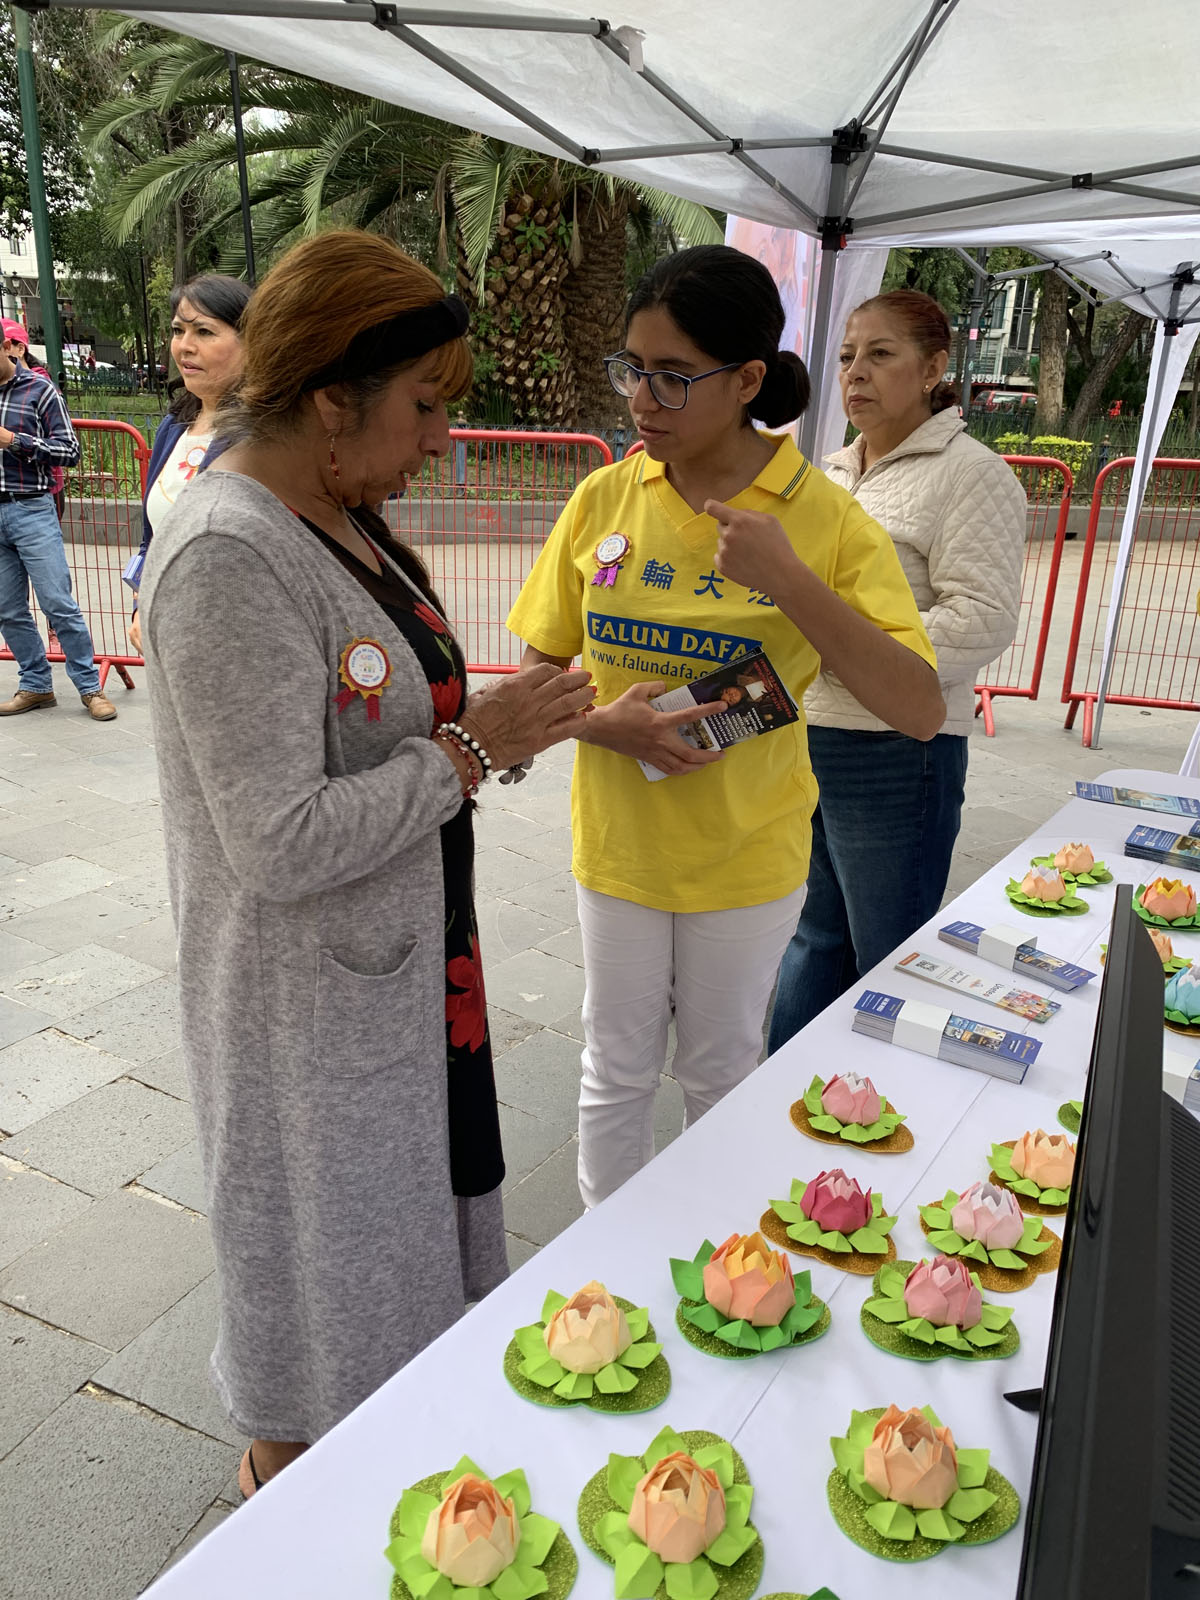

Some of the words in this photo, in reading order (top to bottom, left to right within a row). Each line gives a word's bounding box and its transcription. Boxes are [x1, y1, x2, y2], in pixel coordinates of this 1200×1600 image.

[971, 374, 1007, 384] SUSHI
[591, 617, 670, 649] FALUN
[680, 632, 748, 661] DAFA
